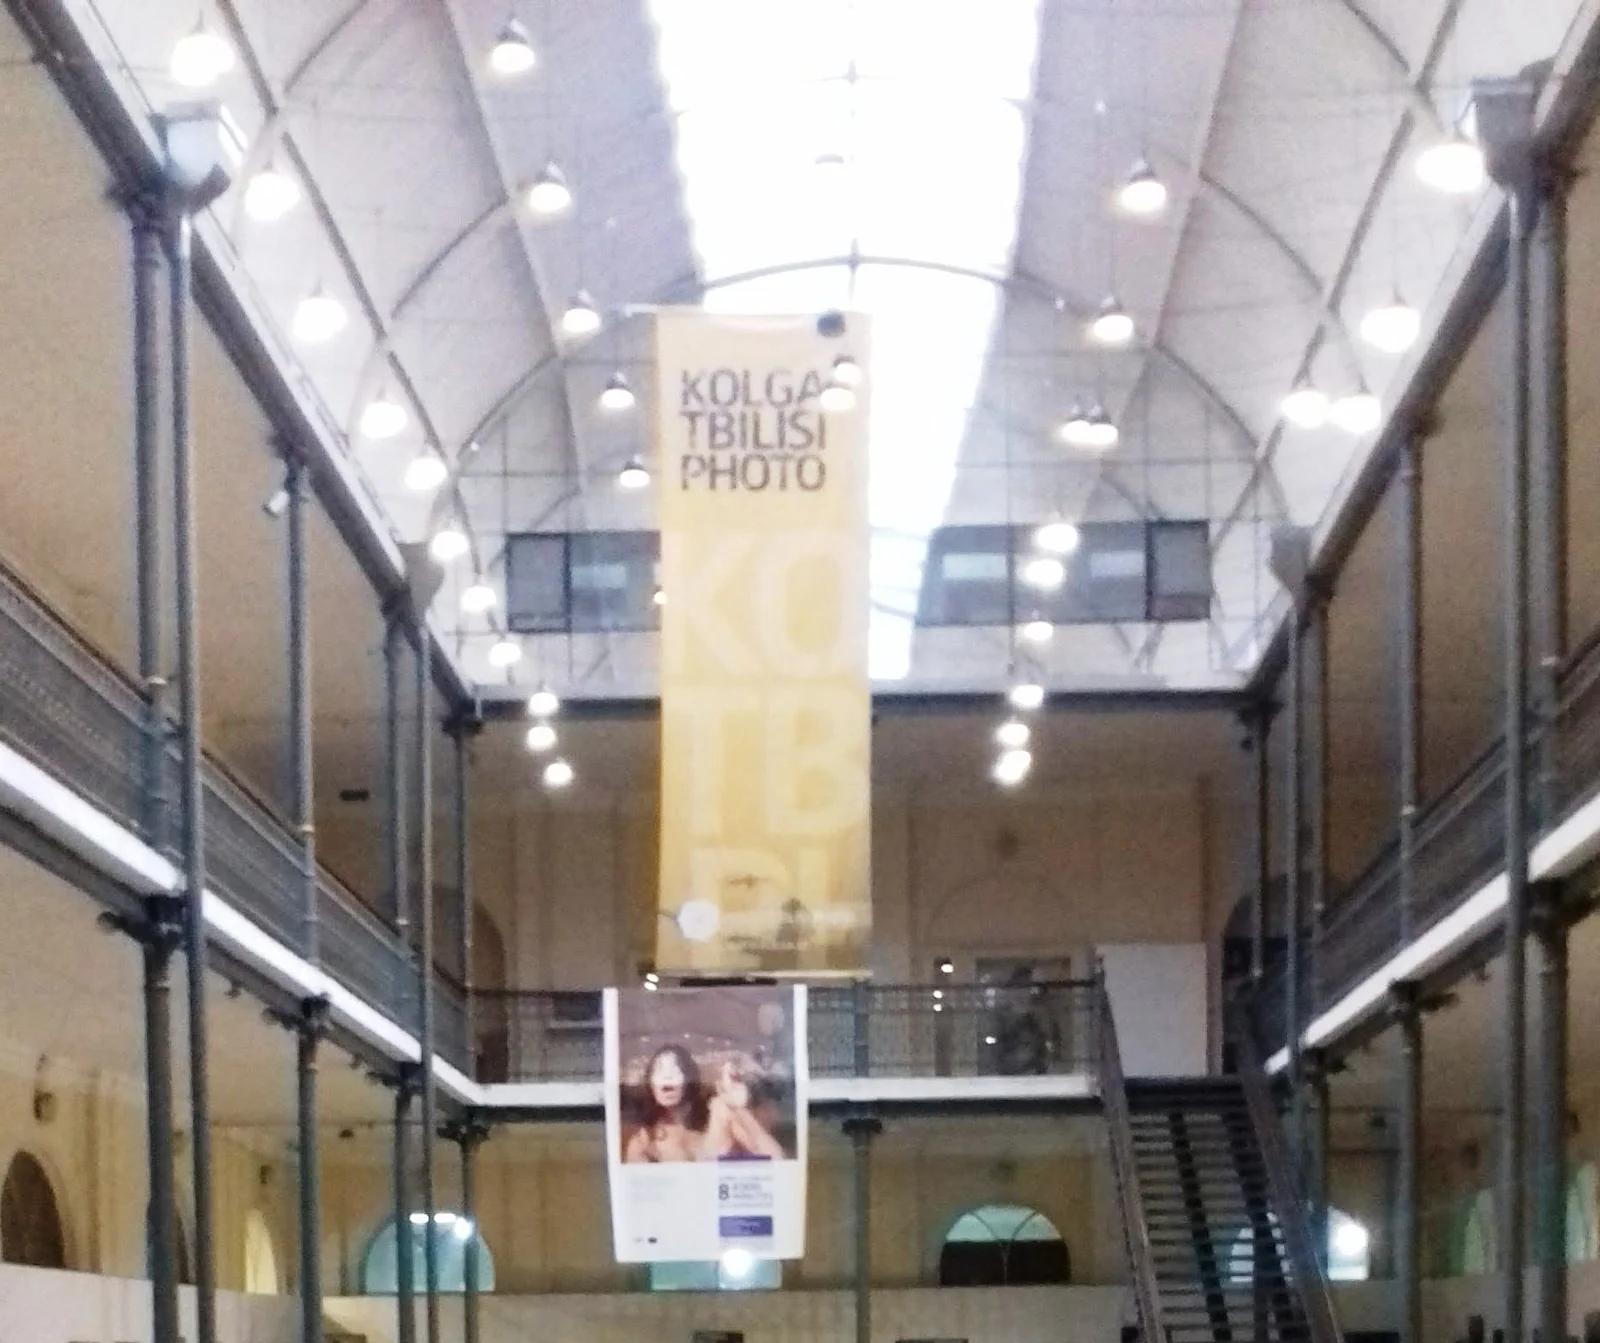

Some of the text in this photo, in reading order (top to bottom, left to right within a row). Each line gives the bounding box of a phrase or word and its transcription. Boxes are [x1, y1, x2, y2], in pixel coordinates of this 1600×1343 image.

[682, 368, 825, 408] KOLGA
[681, 411, 827, 450] TBILISI
[681, 454, 827, 491] PHOTO
